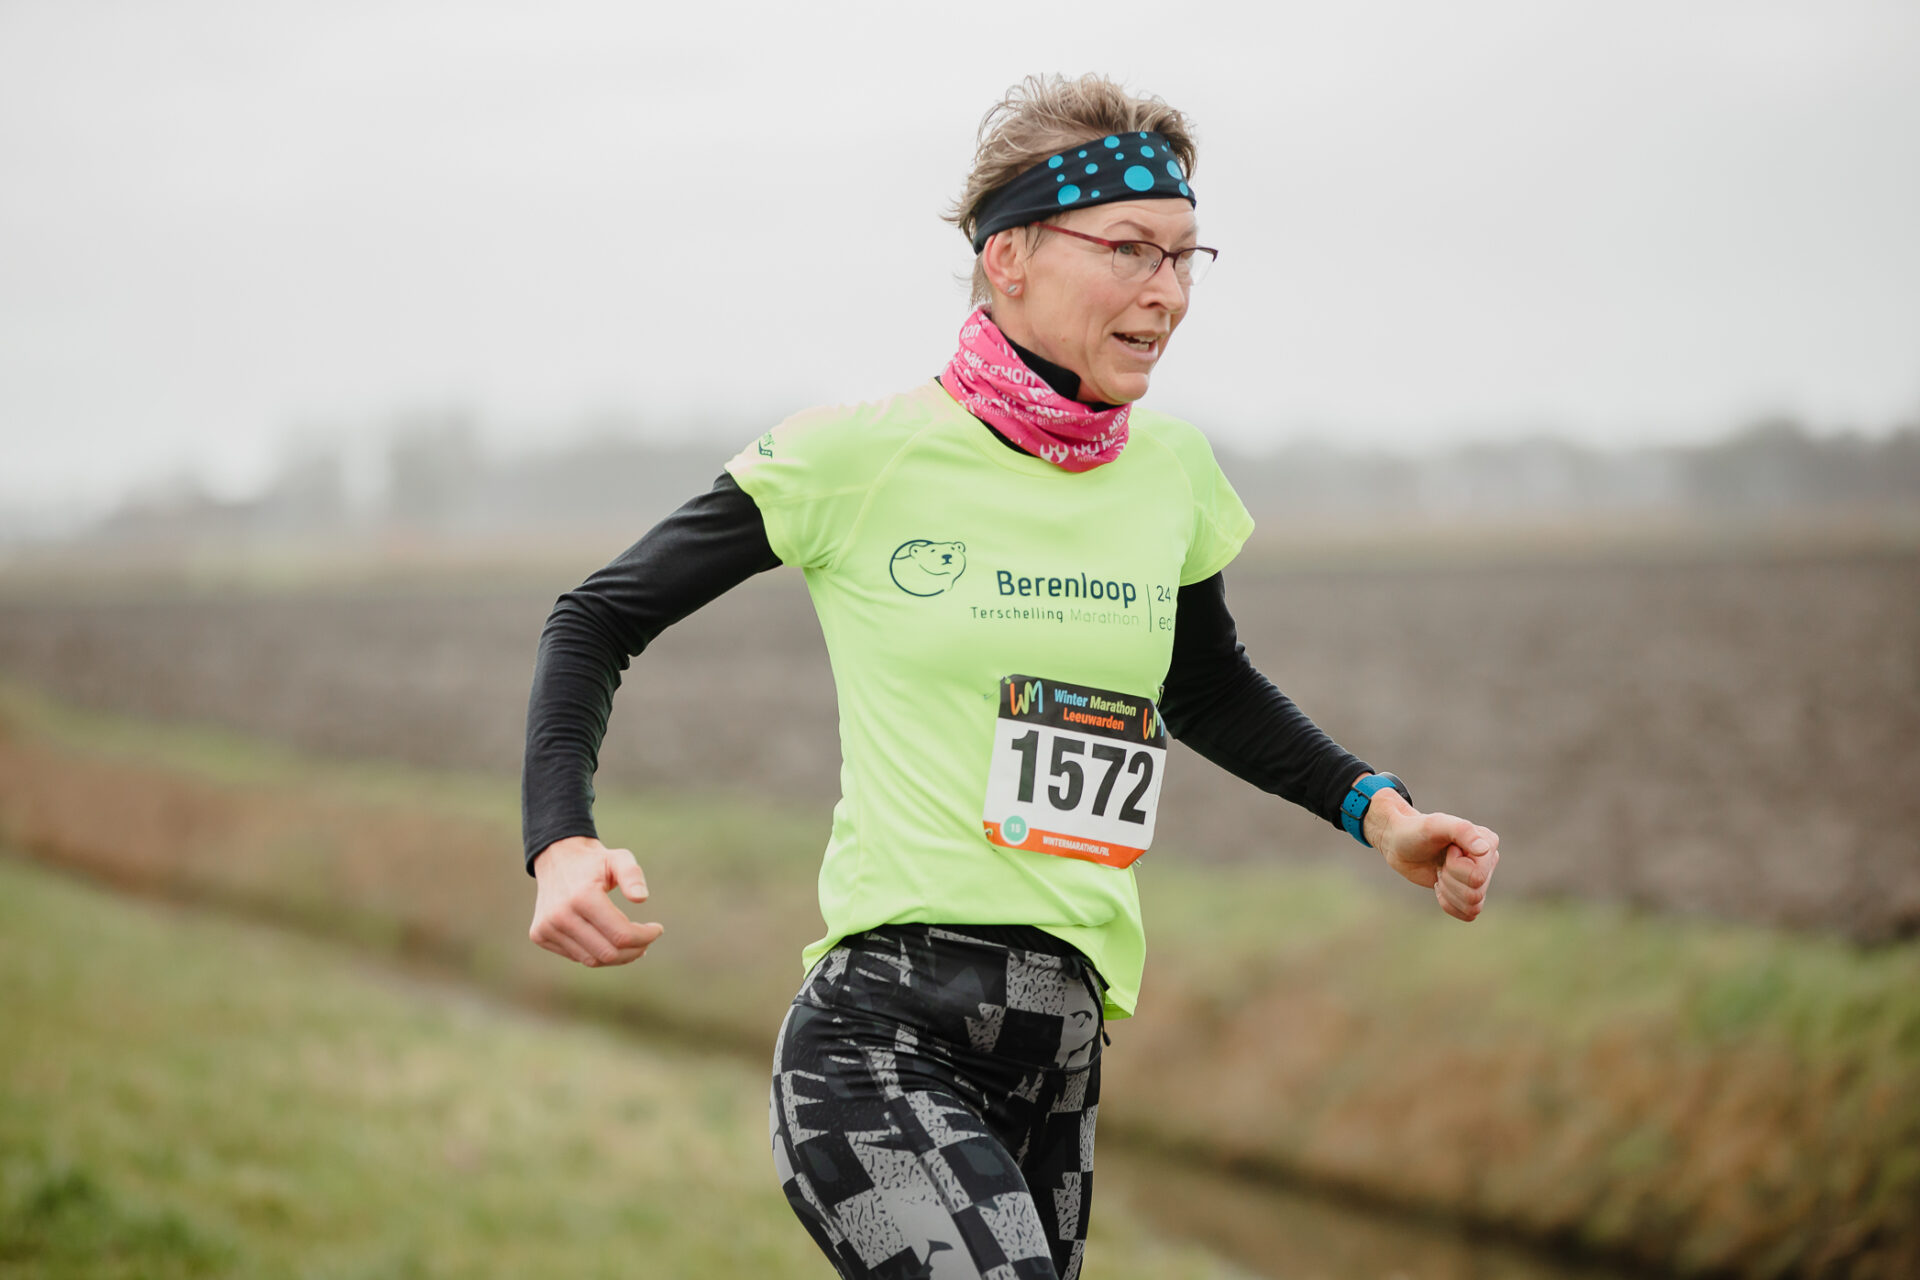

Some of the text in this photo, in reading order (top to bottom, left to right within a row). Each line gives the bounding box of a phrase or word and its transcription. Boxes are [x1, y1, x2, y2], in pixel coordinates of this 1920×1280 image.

[997, 570, 1136, 608] Berenloop
[1156, 584, 1171, 603] 24
[970, 606, 1139, 626] Terschelling Marathon
[1054, 688, 1137, 717] Winter Marathon
[1063, 707, 1125, 732] Leeuwarden
[1011, 729, 1154, 825] 1572
